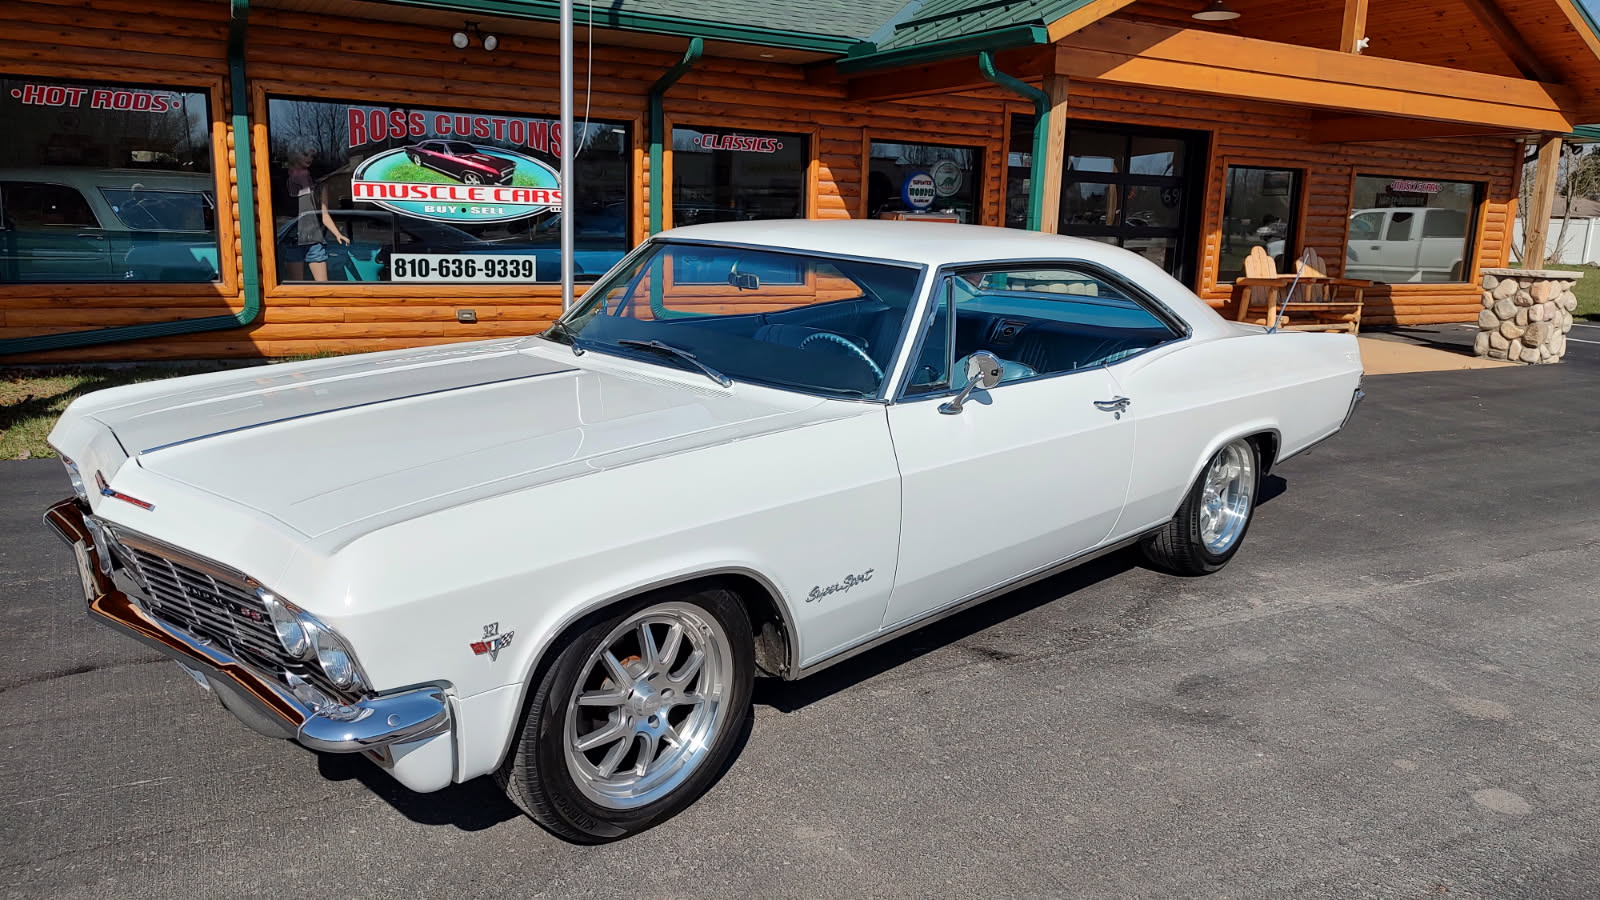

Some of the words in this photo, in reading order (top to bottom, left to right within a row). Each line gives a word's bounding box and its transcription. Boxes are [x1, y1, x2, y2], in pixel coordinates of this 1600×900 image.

[22, 84, 88, 108] HOT
[91, 89, 171, 113] RODS
[348, 108, 426, 149] ROSS
[434, 114, 562, 159] CUSTOMS
[700, 133, 777, 153] CLASSICS
[353, 182, 486, 201] MUSCLE
[494, 187, 562, 203] CARS
[424, 205, 457, 214] BUY
[470, 206, 505, 215] SELL
[394, 258, 533, 278] 810-636-9339
[805, 584, 848, 603] Super
[844, 568, 874, 593] Sport
[482, 621, 500, 640] 327
